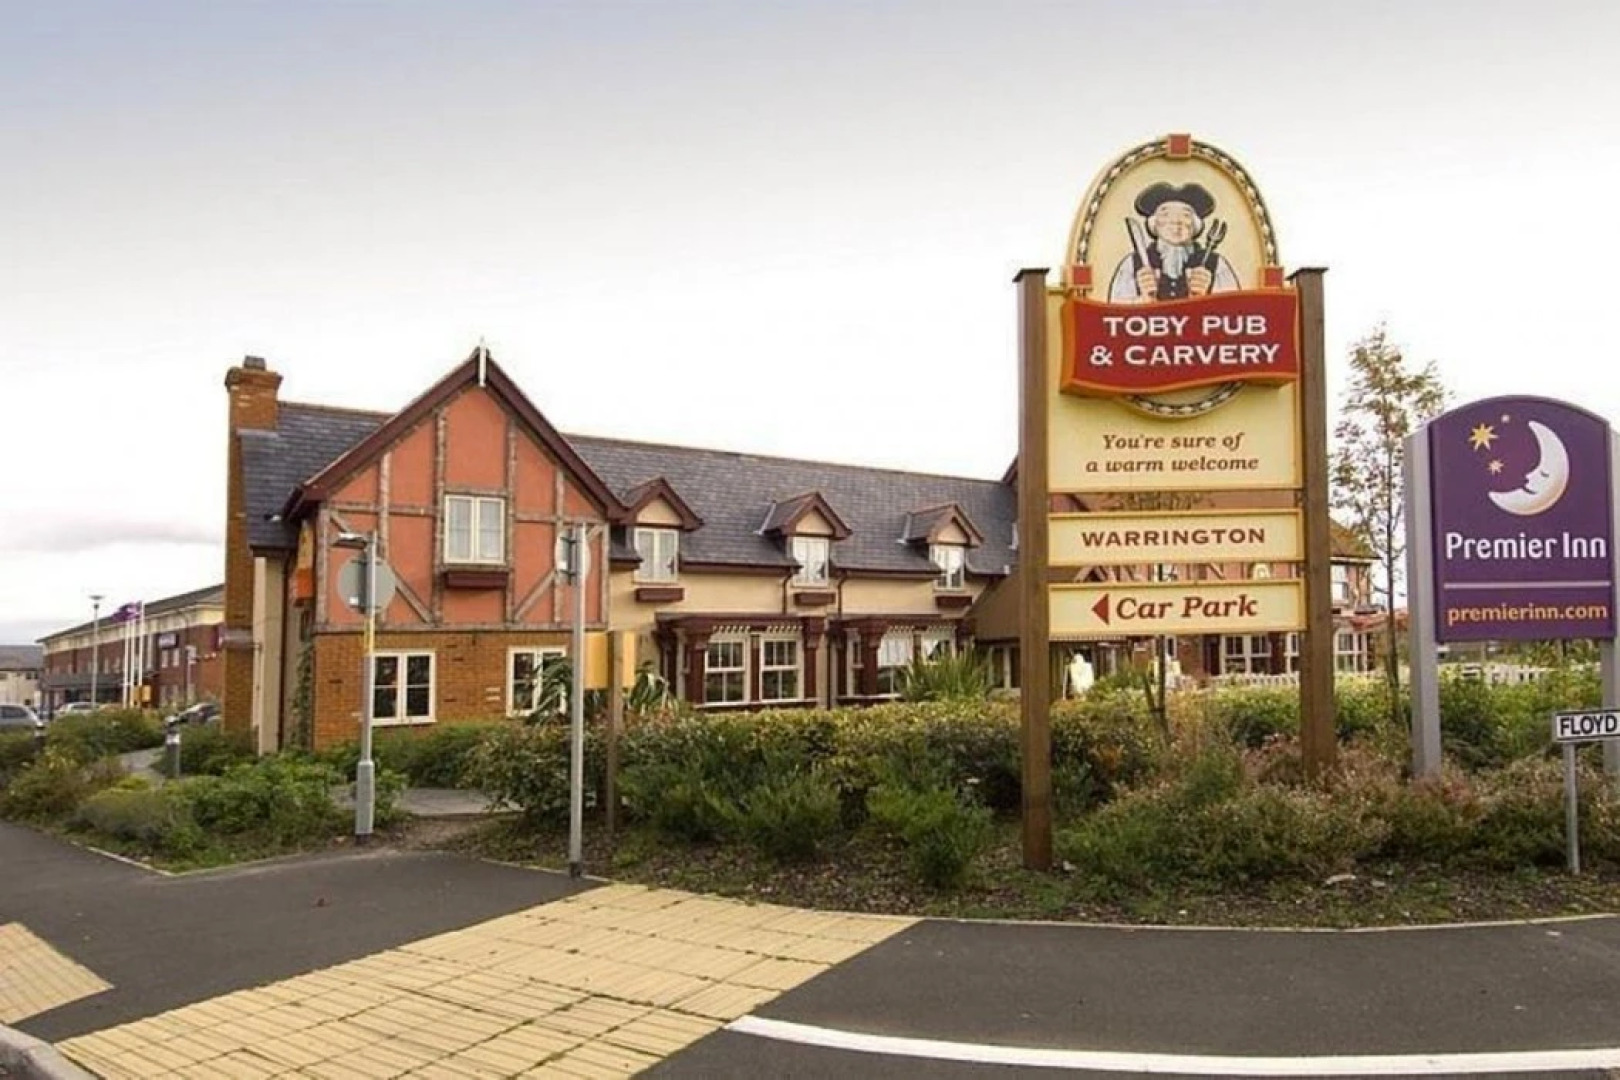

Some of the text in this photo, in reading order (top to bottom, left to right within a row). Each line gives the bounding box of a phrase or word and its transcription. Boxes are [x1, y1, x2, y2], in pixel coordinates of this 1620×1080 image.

[1102, 314, 1267, 337] TOBY PUB
[1089, 343, 1281, 367] & CARVERY
[1102, 432, 1245, 451] You're sure of
[1085, 456, 1259, 473] a warm welcome
[1081, 528, 1265, 547] WARRINGTON
[1445, 532, 1606, 560] Premier Inn
[1115, 594, 1258, 620] Car Park
[1447, 602, 1608, 625] premierinn.com
[1559, 714, 1618, 736] FLOYD
